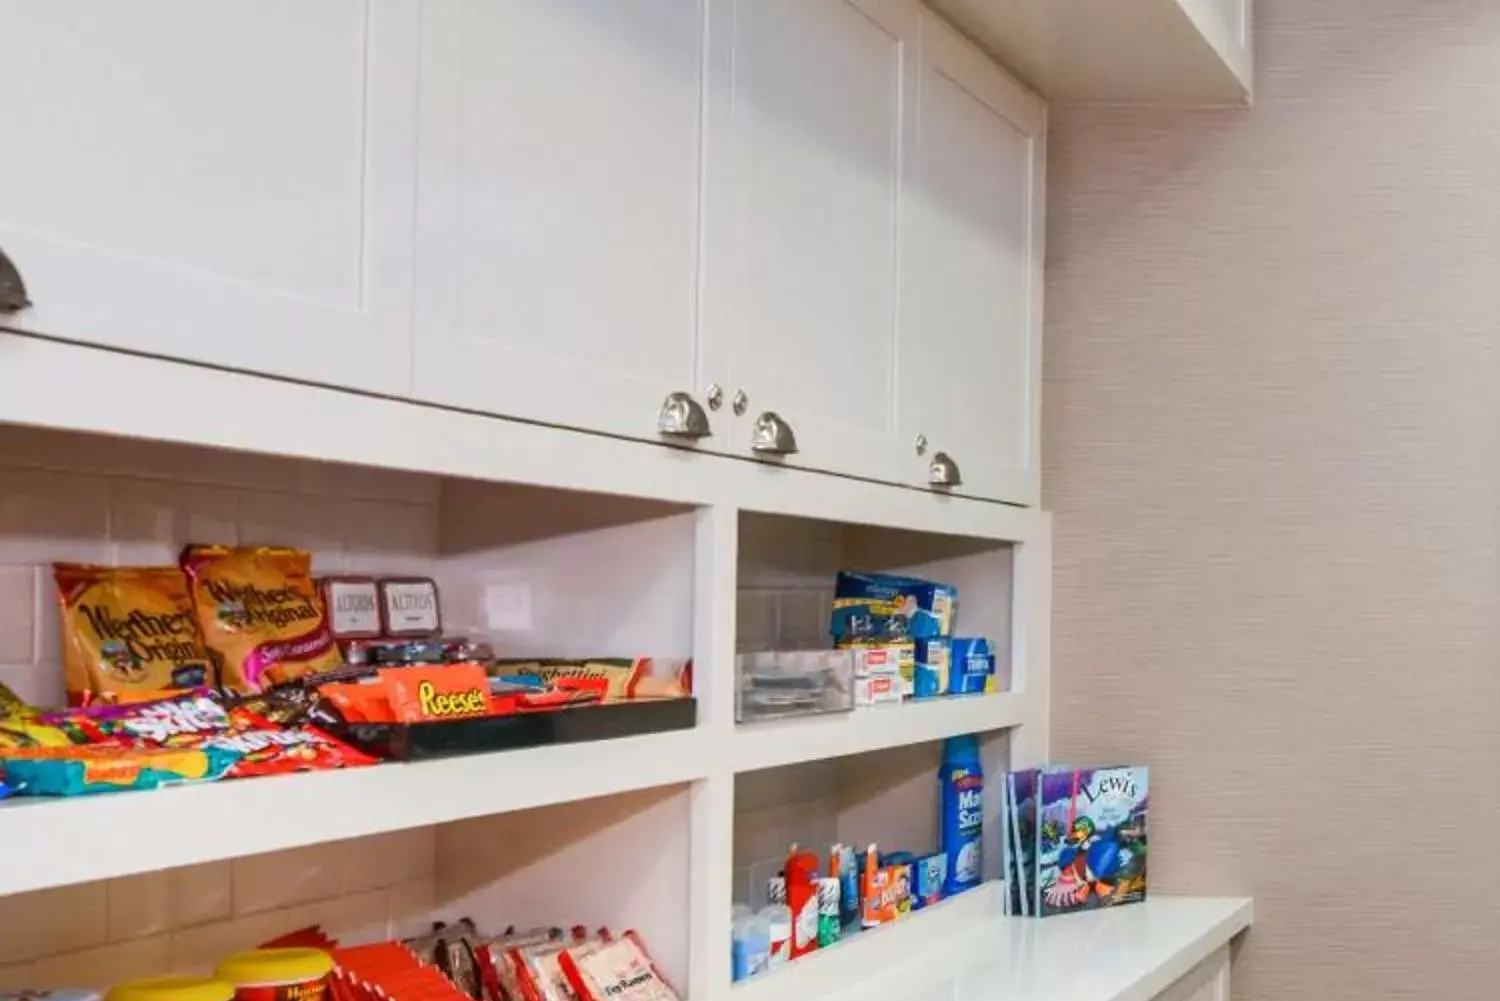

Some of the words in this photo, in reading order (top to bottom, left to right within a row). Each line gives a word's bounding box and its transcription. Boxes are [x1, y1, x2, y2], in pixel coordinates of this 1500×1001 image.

[126, 638, 196, 665] Origin
[418, 680, 486, 716] Reese's
[1081, 772, 1138, 803] Lewis
